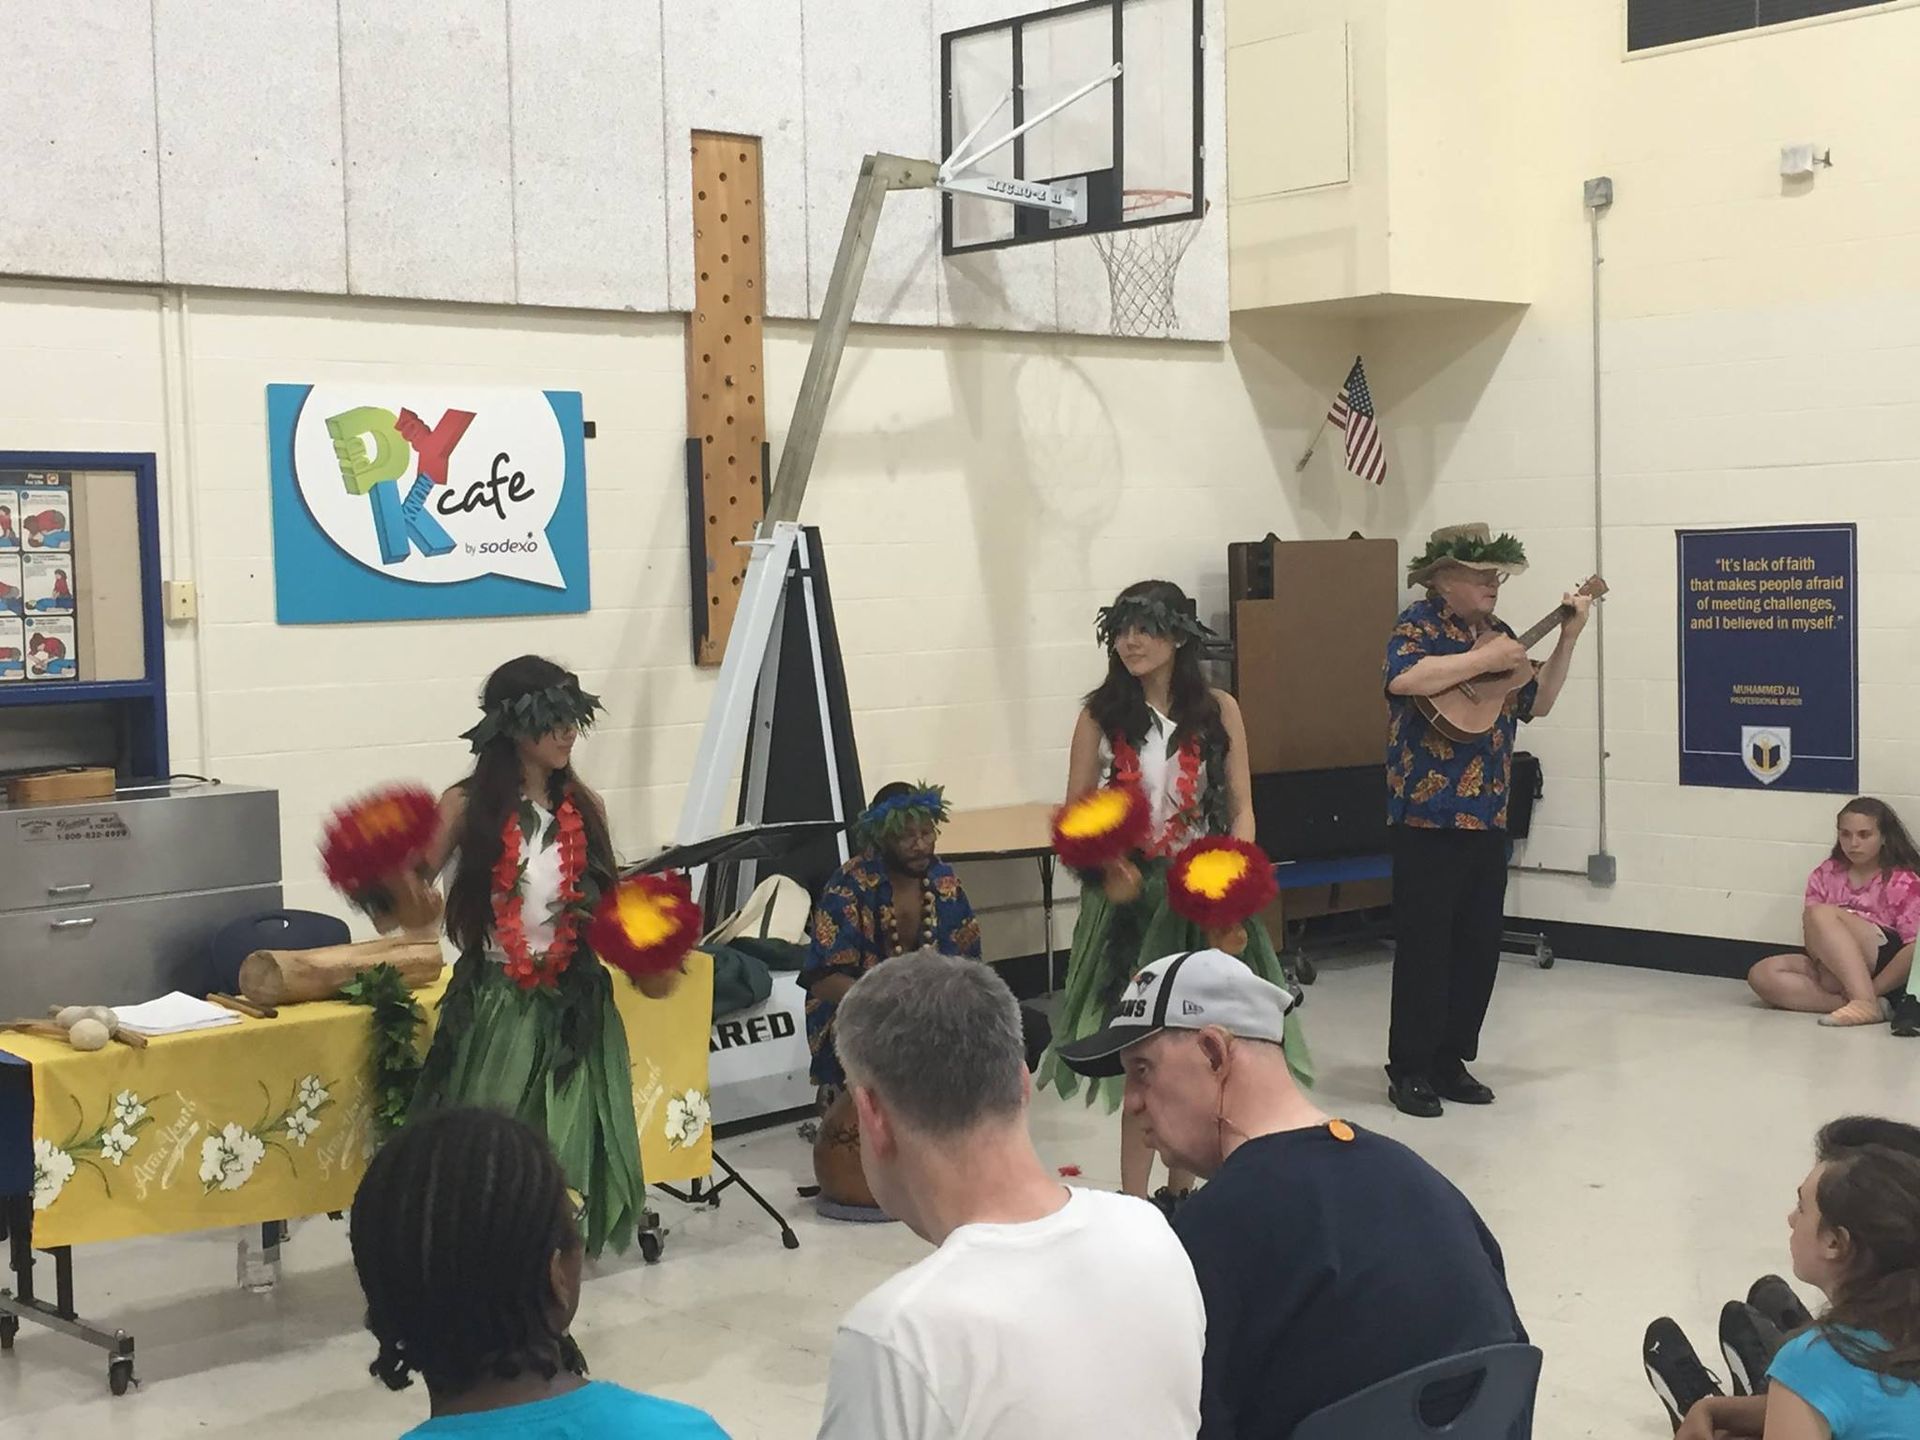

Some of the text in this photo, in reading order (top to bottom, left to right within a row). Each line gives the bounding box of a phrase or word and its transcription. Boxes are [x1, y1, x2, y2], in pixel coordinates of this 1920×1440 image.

[437, 452, 535, 520] cafe
[465, 536, 538, 556] by sodexo
[1743, 557, 1769, 572] lack
[1771, 557, 1785, 571] of
[1786, 556, 1815, 571] faith
[1690, 576, 1844, 593] that makes people afraid
[1697, 596, 1836, 613] of meeting challenges,
[1690, 616, 1713, 629] and
[1715, 616, 1720, 629] I
[1722, 616, 1773, 630] believed
[1777, 615, 1788, 629] in
[1786, 685, 1800, 696] ALI
